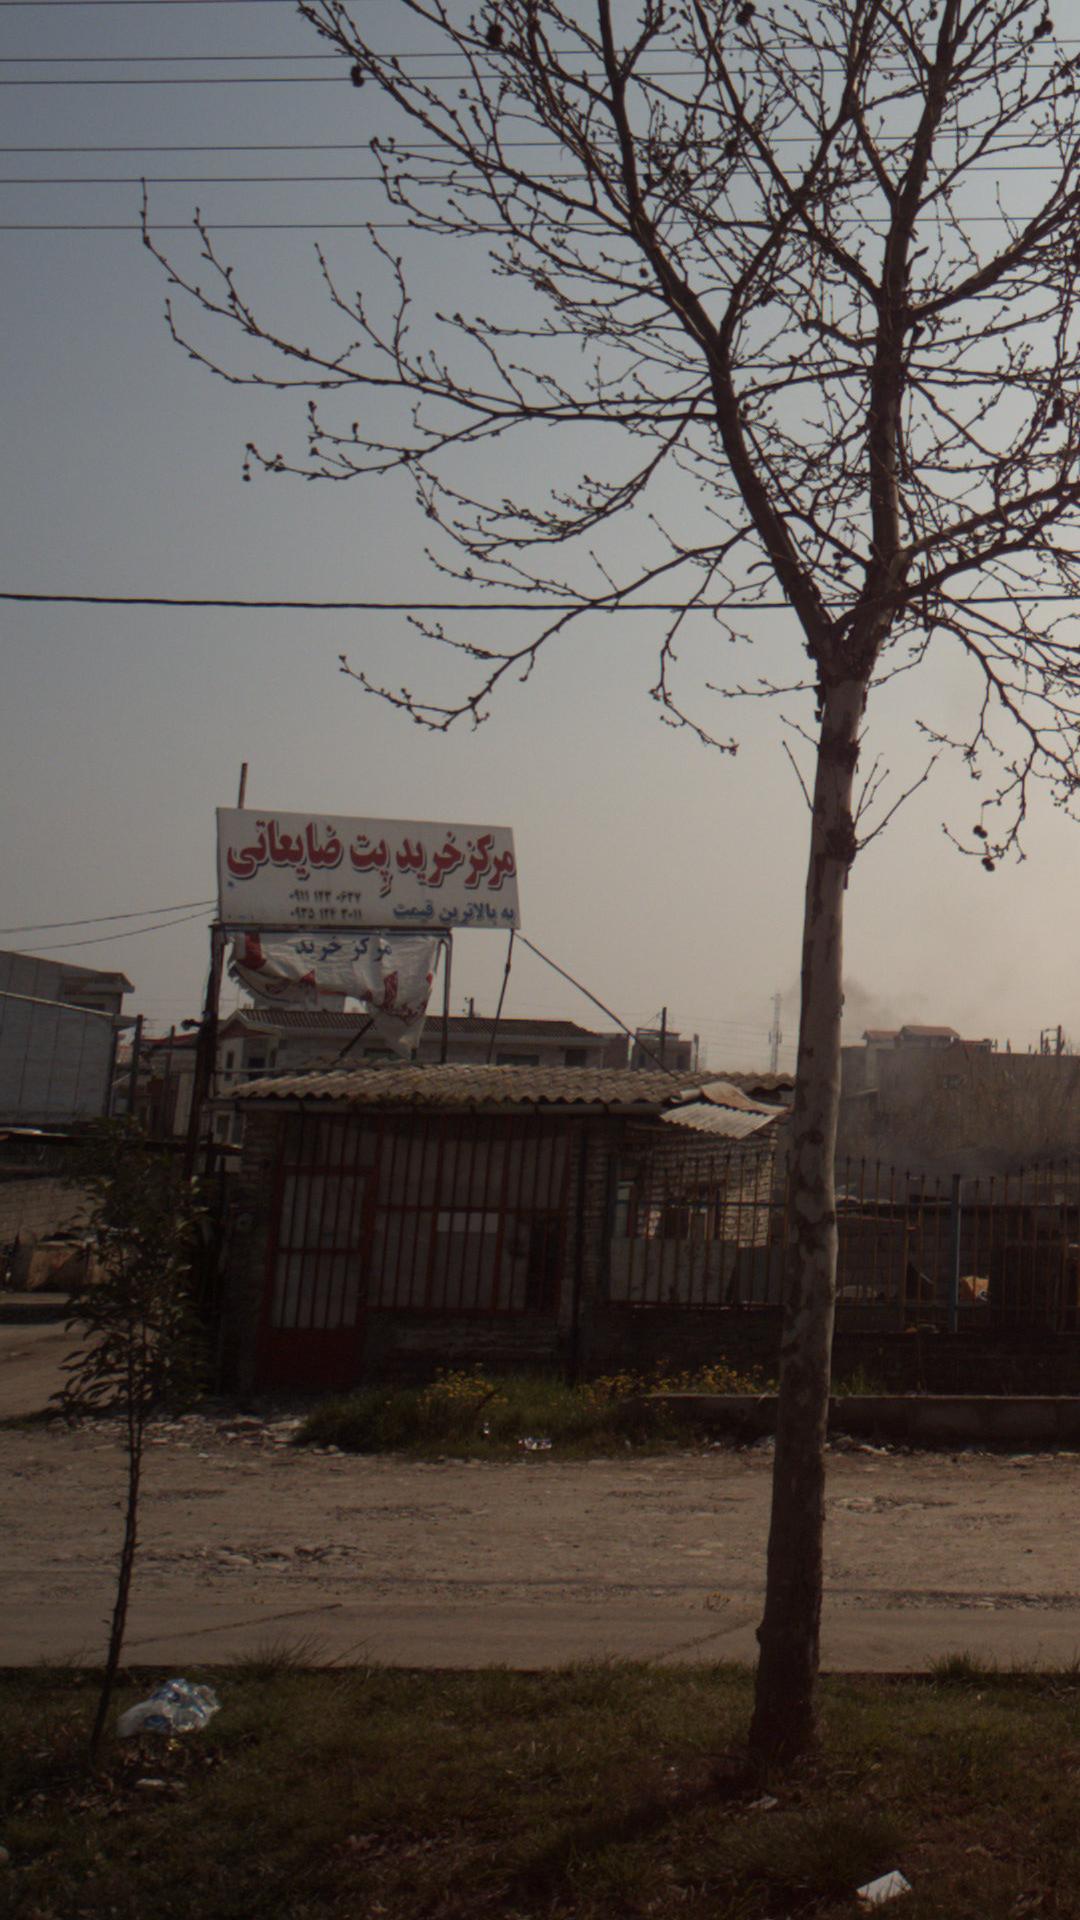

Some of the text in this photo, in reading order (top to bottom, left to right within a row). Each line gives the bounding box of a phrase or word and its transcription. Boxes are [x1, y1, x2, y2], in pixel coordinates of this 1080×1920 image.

[226, 820, 342, 879] ضایعاتی
[396, 831, 464, 885] خرید
[465, 834, 516, 888] مرکز
[393, 899, 434, 922] قیمت
[439, 902, 497, 925] بالاترین
[295, 936, 343, 962] خرید
[351, 936, 393, 962] مرکز
